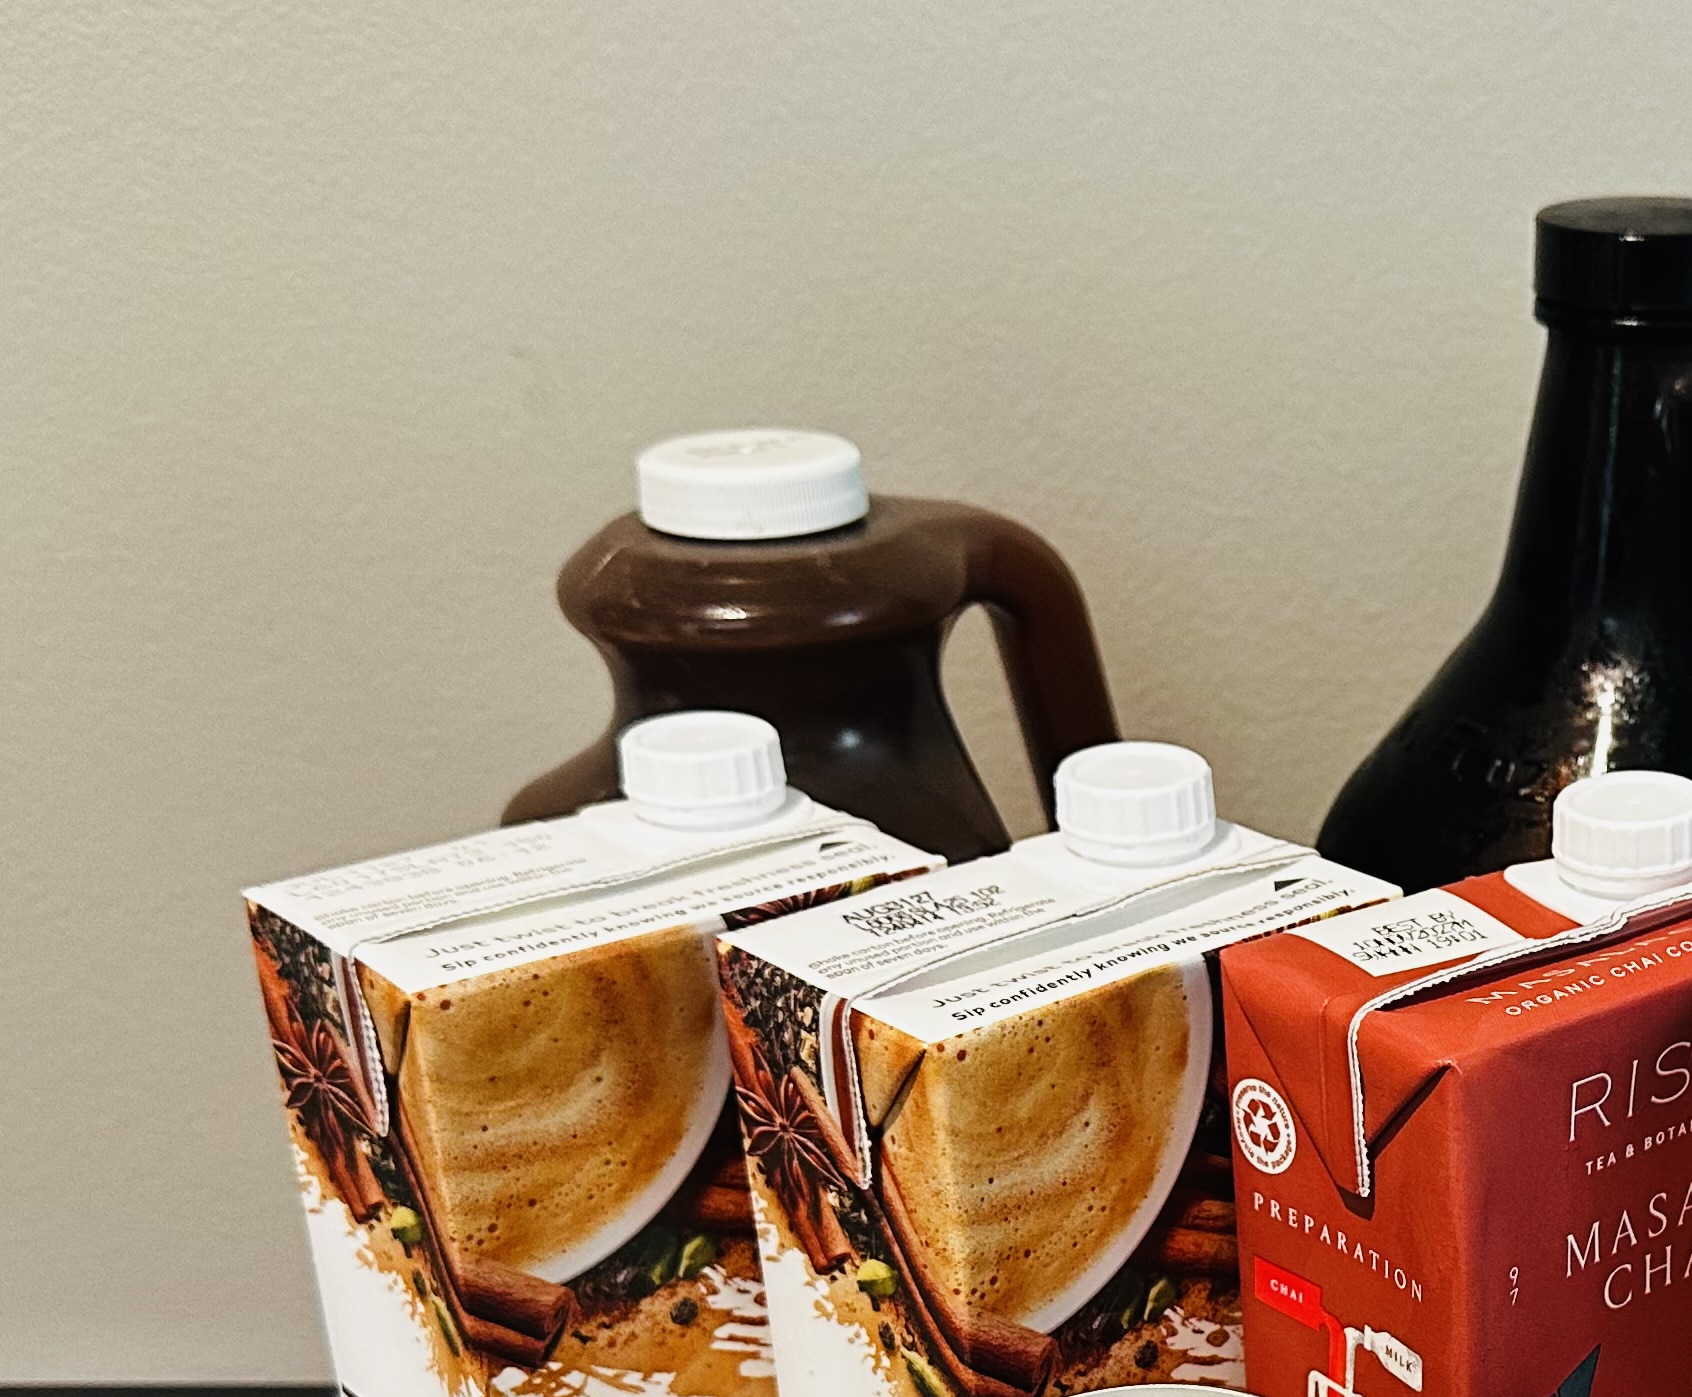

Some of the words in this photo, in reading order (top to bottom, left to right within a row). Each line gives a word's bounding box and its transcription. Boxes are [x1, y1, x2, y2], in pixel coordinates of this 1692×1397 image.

[952, 1002, 985, 1021] Sip
[990, 963, 1091, 1010] confidently
[1096, 940, 1170, 970] knowing
[1171, 934, 1197, 945] we
[1505, 975, 1606, 1016] ORGANIC
[1610, 953, 1663, 979] CHAI
[1586, 1152, 1617, 1175] TEA
[1625, 1144, 1635, 1158] &
[1253, 1192, 1422, 1303] PREPARATION
[1270, 1279, 1303, 1304] CHAI
[1385, 1345, 1413, 1373] MILK
